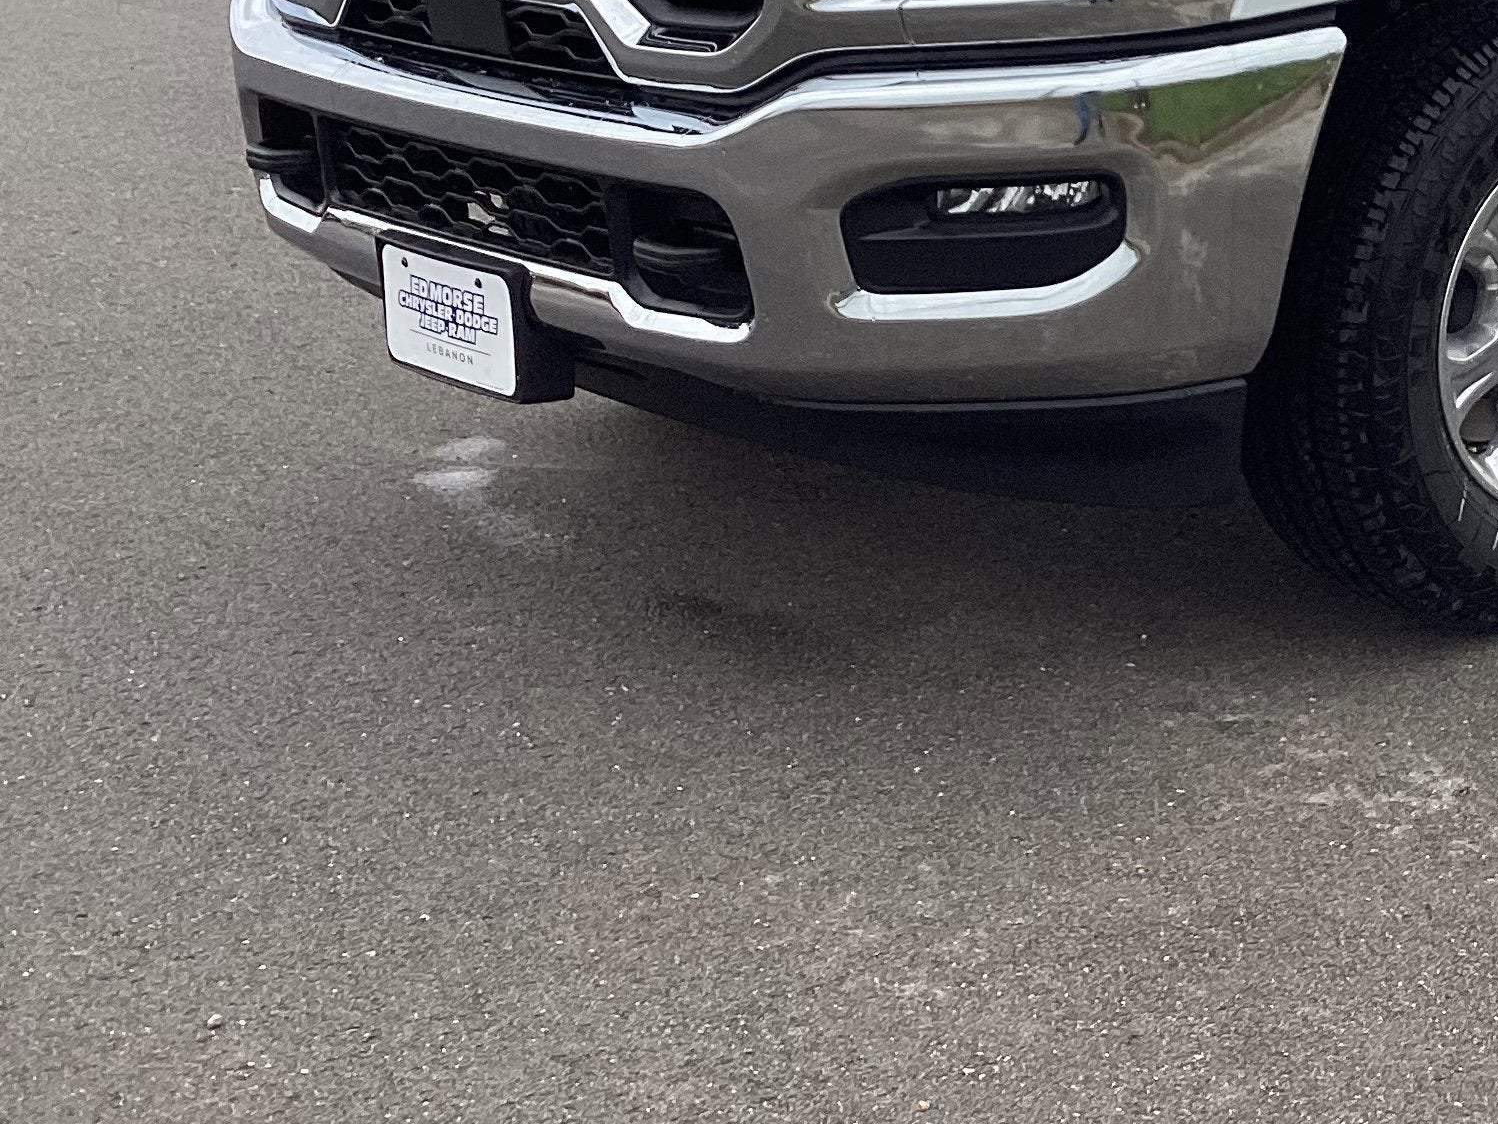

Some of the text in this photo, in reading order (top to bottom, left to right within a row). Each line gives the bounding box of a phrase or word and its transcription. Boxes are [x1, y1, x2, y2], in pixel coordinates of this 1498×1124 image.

[410, 274, 484, 314] ED MORSE
[426, 341, 474, 365] LEBANON
